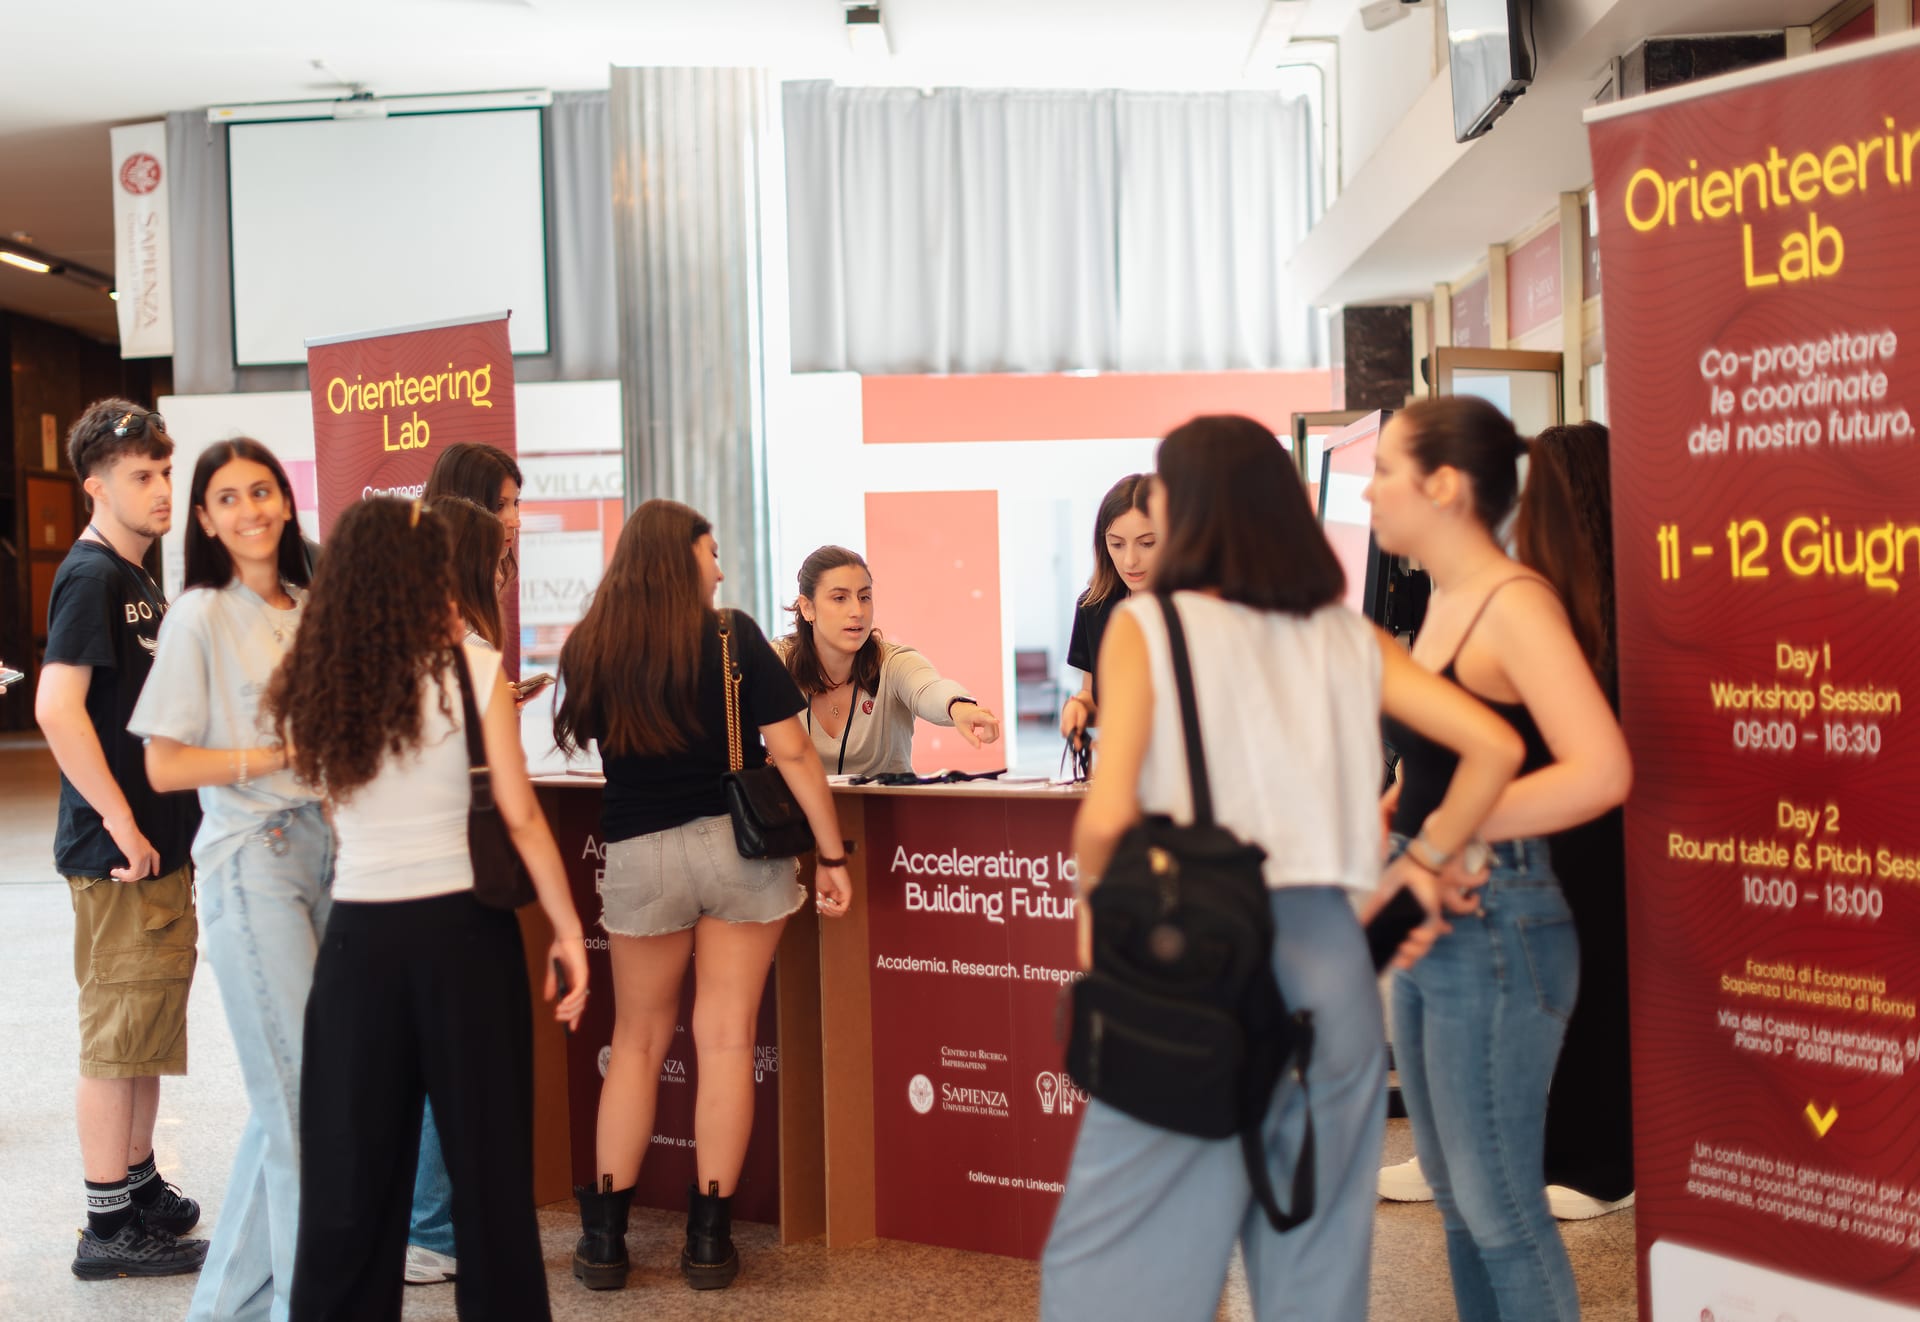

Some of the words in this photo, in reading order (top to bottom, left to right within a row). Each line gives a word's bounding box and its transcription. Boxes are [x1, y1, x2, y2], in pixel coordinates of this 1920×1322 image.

[1743, 213, 1845, 288] Lab
[1700, 330, 1898, 382] Co-progettare
[327, 362, 493, 415] Orienteering
[1711, 385, 1735, 416] le
[1741, 369, 1888, 412] coordinate
[383, 411, 431, 452] Lab
[1688, 424, 1729, 456] del
[1737, 415, 1821, 451] nostro
[1828, 409, 1916, 443] futuro.
[1657, 523, 1681, 580] 11
[1727, 520, 1770, 578] 12
[1782, 516, 1920, 592] Giugn
[1776, 643, 1818, 677] Day
[1824, 643, 1831, 670] 1
[1710, 682, 1815, 717] Workshop
[1820, 684, 1901, 713] Session
[1733, 721, 1797, 749] 09:00
[1824, 723, 1881, 753] 16:30
[1777, 802, 1819, 837] Day
[1825, 805, 1839, 831] 2
[890, 845, 1050, 888] Accelerating
[1668, 833, 1735, 862] Round
[1741, 840, 1789, 867] table
[1794, 844, 1812, 869] &
[1817, 845, 1871, 875] Pitch
[905, 882, 1004, 923] Building
[1743, 876, 1797, 907] 10:00
[1825, 886, 1883, 917] 13:00
[877, 954, 949, 974] Academia.
[952, 959, 1020, 979] Research.
[1814, 969, 1886, 994] Economia
[1721, 974, 1781, 997] Sapienza
[1872, 997, 1916, 1018] Roma
[1717, 1010, 1739, 1028] Via
[1741, 1014, 1762, 1032] del
[1764, 1017, 1810, 1040] Castro
[1734, 1031, 1772, 1052] Piano
[1795, 1041, 1832, 1063] 00161
[1834, 1048, 1878, 1071] Roma
[1881, 1055, 1904, 1076] RM
[942, 1082, 1009, 1108] SAPIENZA
[1064, 1101, 1073, 1115] H
[968, 1170, 997, 1185] follow
[998, 1177, 1010, 1187] us
[1011, 1178, 1024, 1189] on
[1026, 1178, 1066, 1193] LinkedIn
[1690, 1159, 1738, 1183] insieme
[1741, 1171, 1751, 1187] le
[1753, 1179, 1823, 1205] coordinate
[1695, 1141, 1712, 1158] Un
[1714, 1149, 1774, 1173] confronto
[1776, 1160, 1795, 1178] tra
[1797, 1168, 1876, 1197] generazioni
[1879, 1185, 1904, 1204] per
[1757, 1196, 1838, 1228] competenze
[1840, 1218, 1850, 1231] e
[1853, 1220, 1905, 1245] mondo
